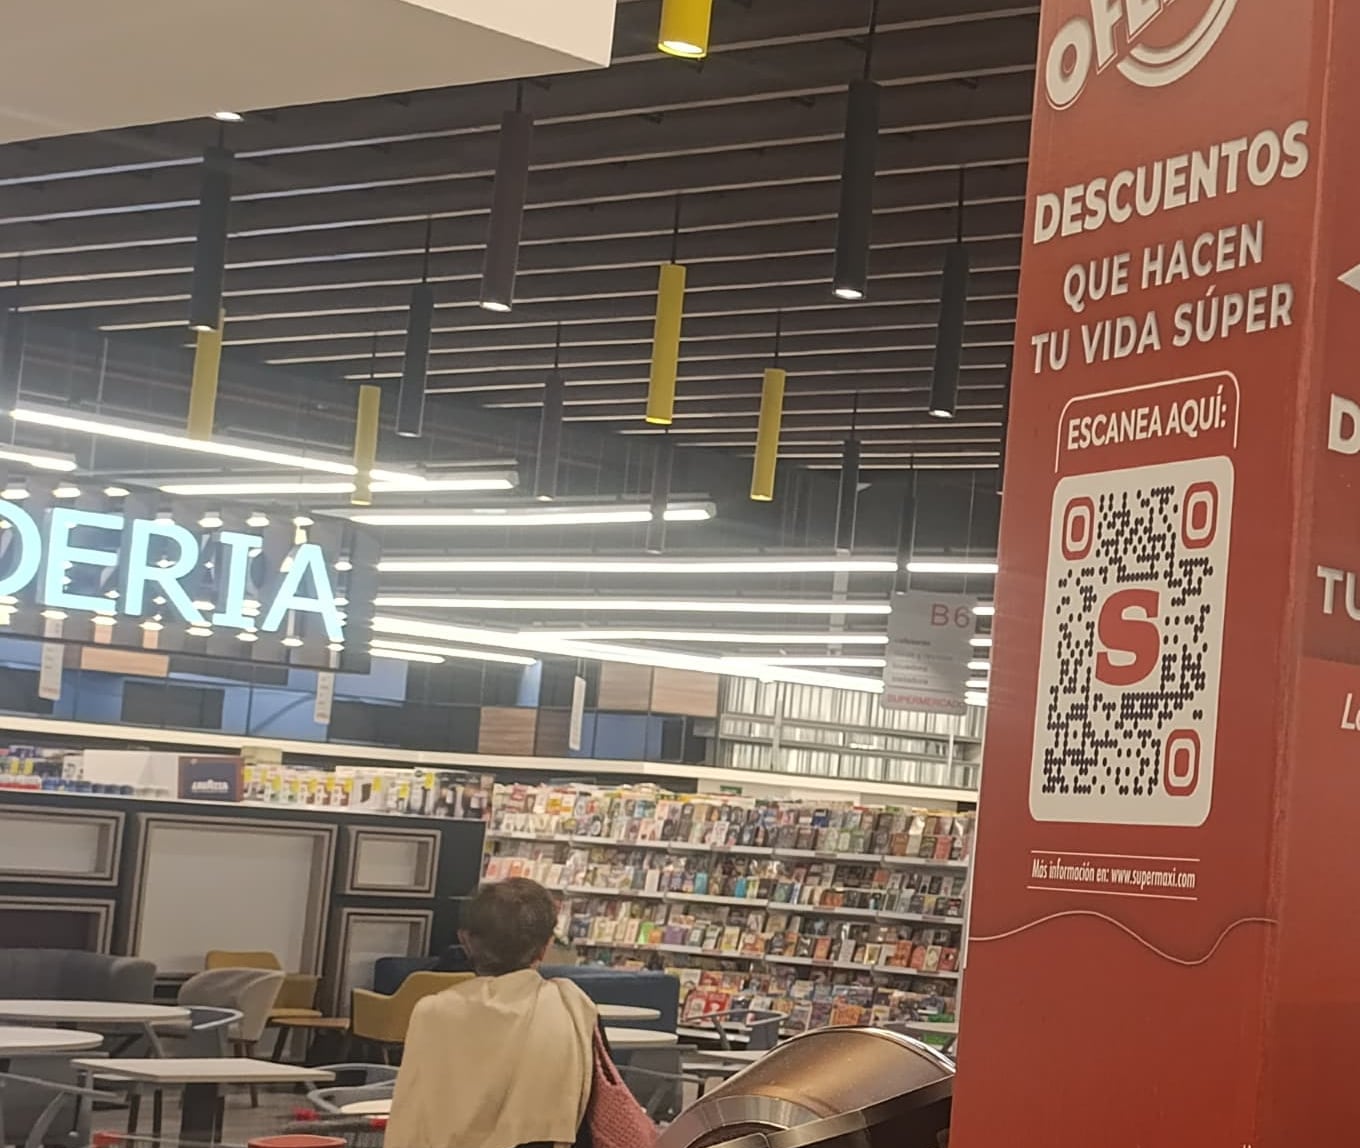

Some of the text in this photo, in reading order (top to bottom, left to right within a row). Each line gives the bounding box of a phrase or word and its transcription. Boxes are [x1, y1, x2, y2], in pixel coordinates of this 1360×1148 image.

[1033, 120, 1310, 244] DESCUENTOS
[1063, 220, 1265, 302] QUE HACEN
[1031, 283, 1295, 375] TU VIDA SÚPER
[1067, 385, 1228, 450] ESCANEA AQUÍ:
[931, 603, 970, 628] B6
[1094, 588, 1161, 686] S
[1031, 857, 1196, 890] Más información en: www.supermaxi.com
